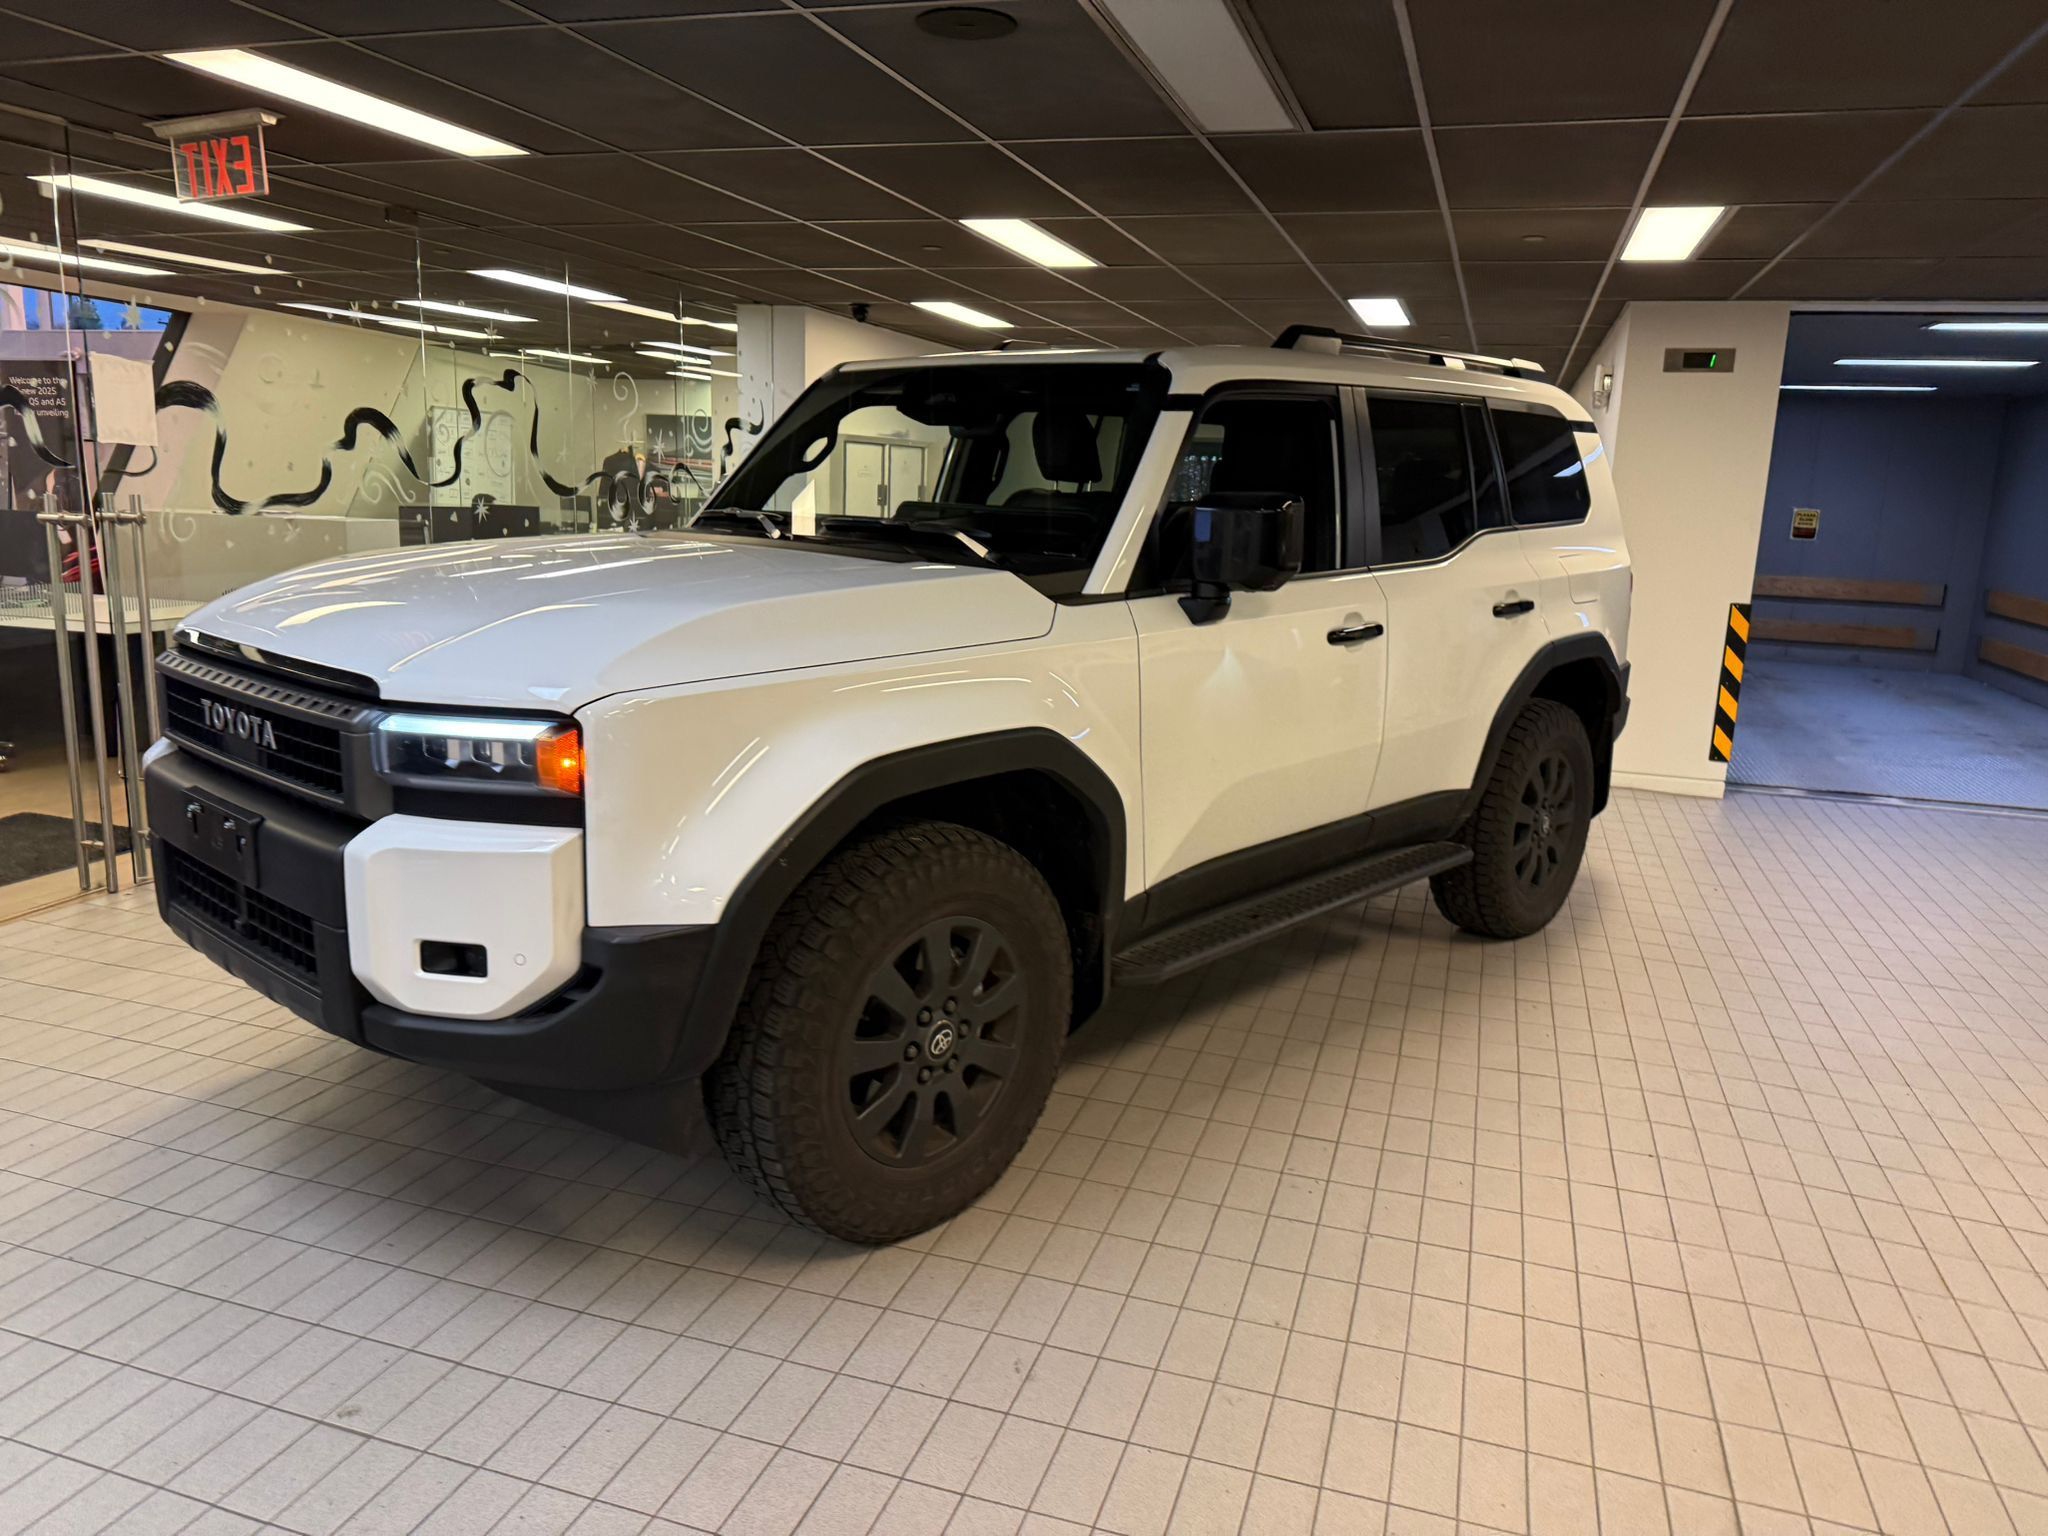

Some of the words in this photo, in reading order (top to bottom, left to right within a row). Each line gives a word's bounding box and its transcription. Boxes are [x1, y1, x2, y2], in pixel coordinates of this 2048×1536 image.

[8, 376, 42, 385] Welcoe
[43, 377, 52, 385] to
[38, 386, 57, 395] 2025
[41, 398, 54, 406] and
[37, 409, 69, 418] unveiling
[200, 698, 278, 750] TOYOTA
